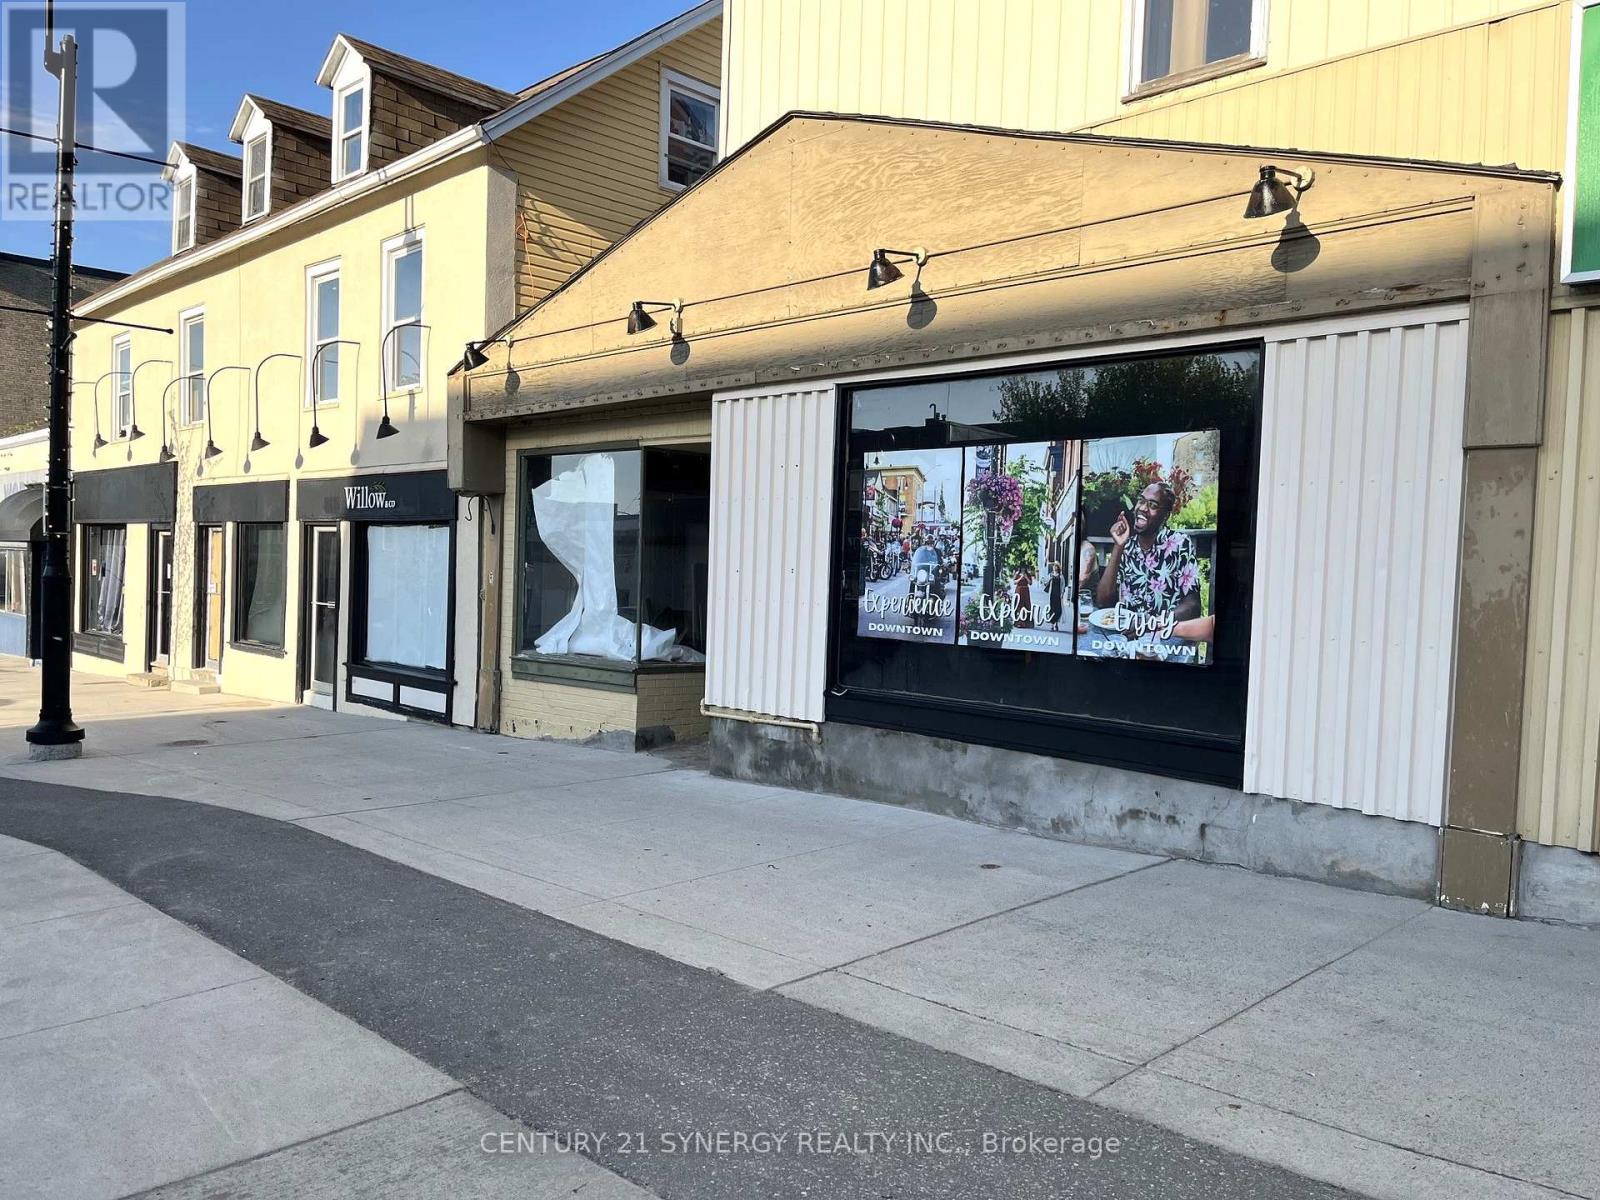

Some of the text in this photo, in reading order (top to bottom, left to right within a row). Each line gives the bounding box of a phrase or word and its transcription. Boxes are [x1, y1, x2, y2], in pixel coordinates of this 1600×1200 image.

[344, 486, 386, 509] Willow
[864, 588, 954, 619] Experience
[977, 593, 1055, 627] Explore
[868, 622, 943, 637] DOWNTOWN
[1113, 601, 1178, 639] Enjoy
[970, 631, 1060, 647] DOWNTOWN
[1091, 640, 1196, 656] DOWNTOWN
